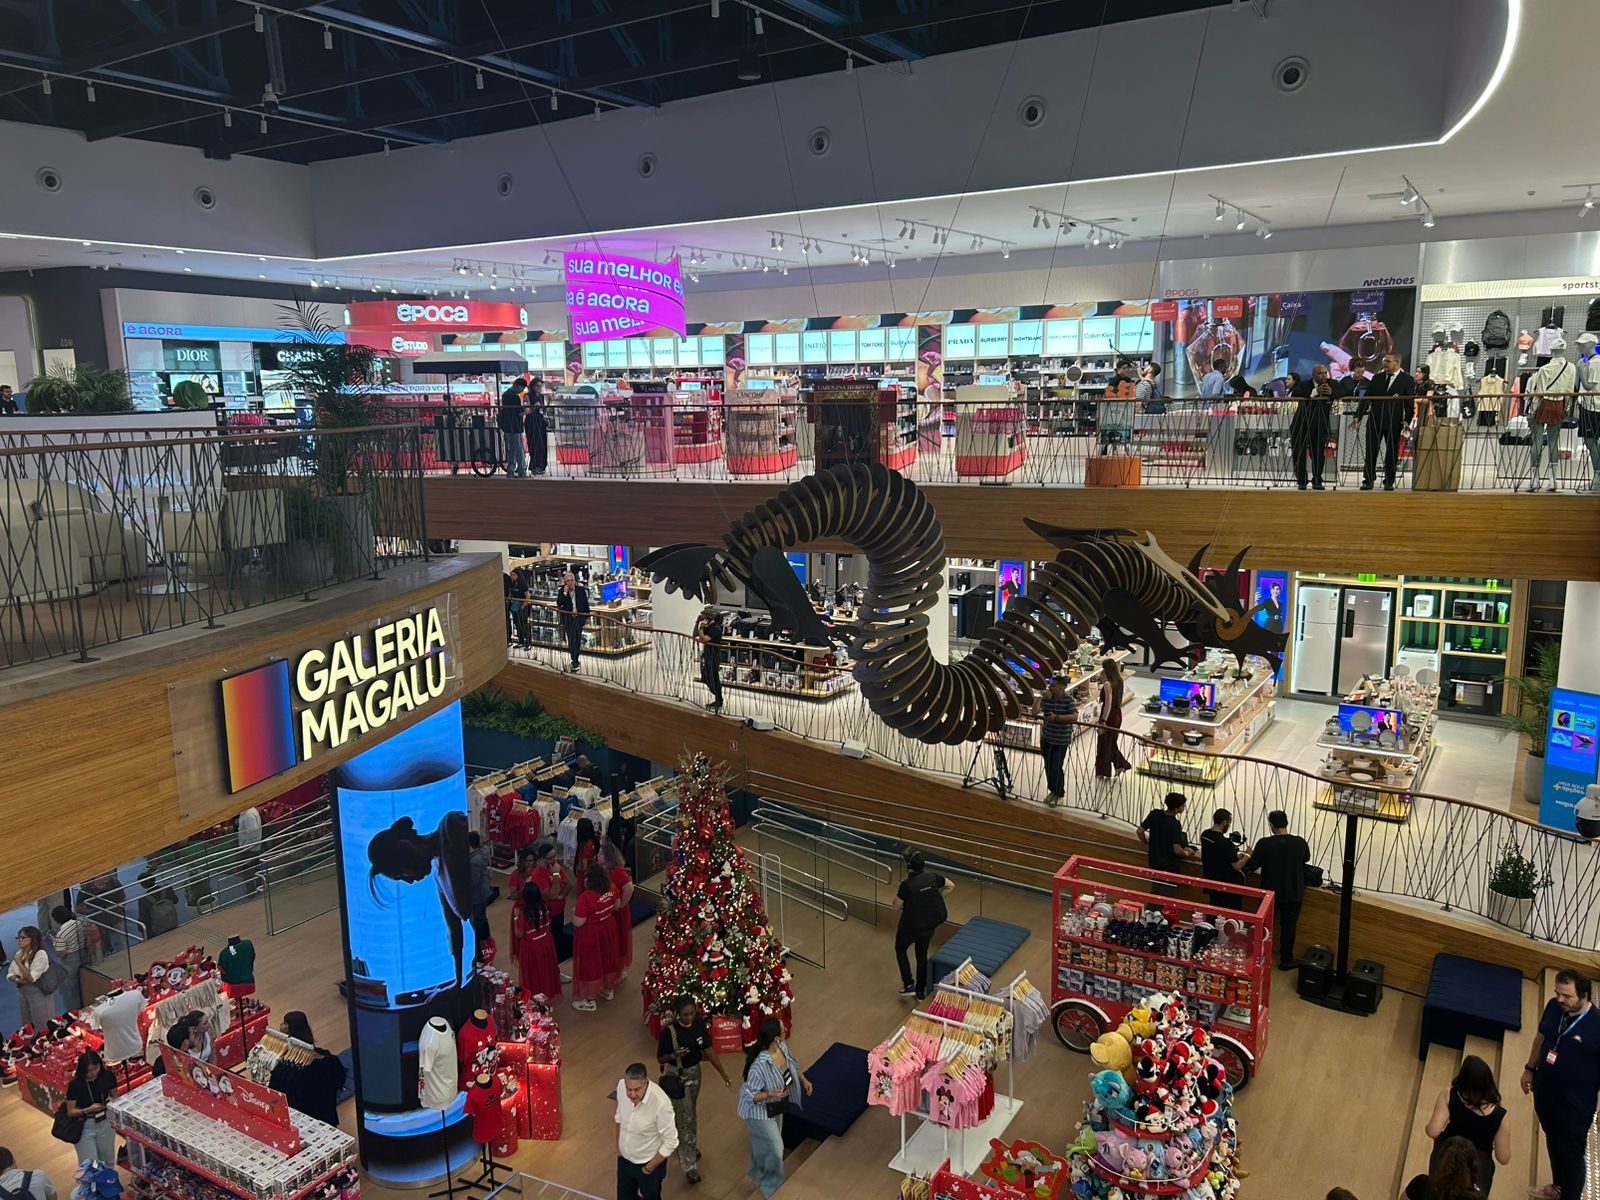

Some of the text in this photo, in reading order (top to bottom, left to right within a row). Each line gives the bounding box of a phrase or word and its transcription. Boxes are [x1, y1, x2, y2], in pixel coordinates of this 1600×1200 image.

[569, 259, 594, 274] sua
[1562, 281, 1600, 291] sportst
[575, 289, 585, 306] é
[1216, 303, 1239, 312] caixa
[575, 320, 599, 336] sua
[177, 349, 209, 362] DIOR
[296, 607, 446, 703] GALERIA
[300, 651, 447, 761] MAGALU
[237, 1085, 270, 1115] Disney
